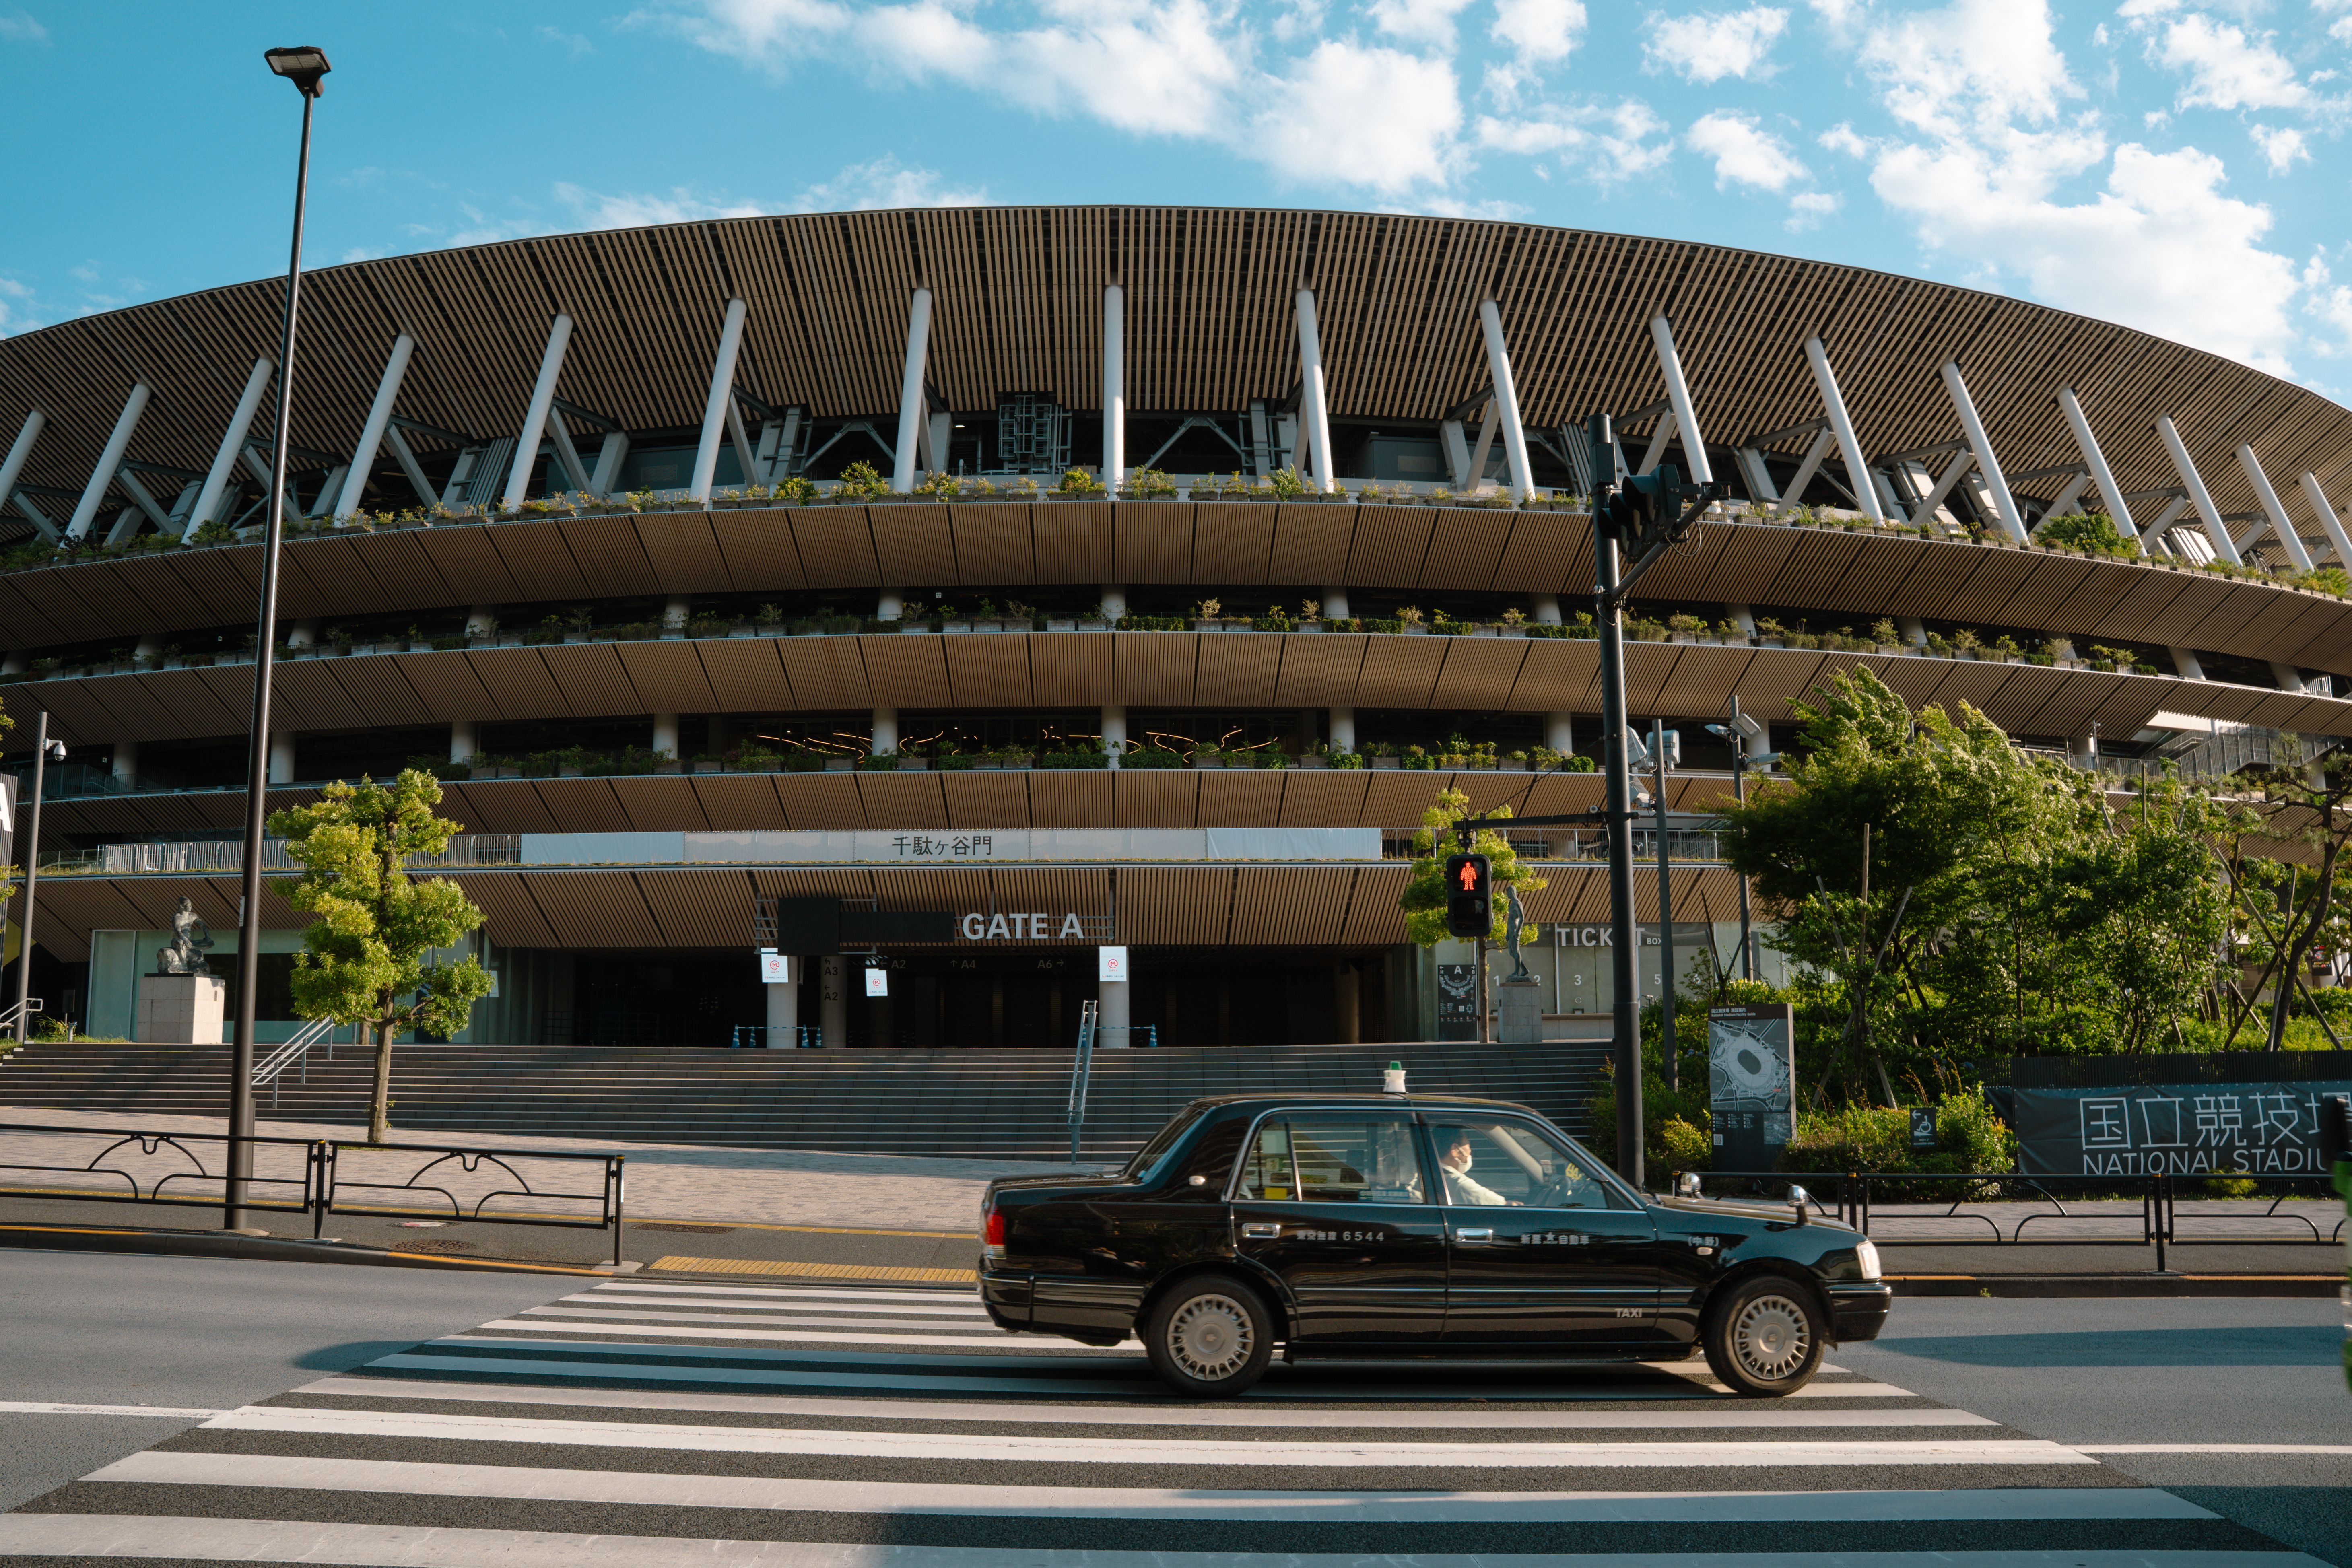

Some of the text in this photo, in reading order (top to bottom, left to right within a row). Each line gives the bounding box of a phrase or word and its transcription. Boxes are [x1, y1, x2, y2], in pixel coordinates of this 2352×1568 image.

[892, 836, 992, 855] 千駄ヶ谷門
[963, 913, 1084, 940] GATE A
[1556, 927, 1645, 946] TICKT
[891, 960, 906, 969] A2
[961, 960, 976, 969] A4
[1037, 959, 1053, 969] A6
[824, 966, 838, 976] A3
[1454, 965, 1462, 974] A
[1493, 975, 1499, 986] 1
[1574, 975, 1581, 985] 3
[1654, 974, 1661, 985] 5
[824, 992, 838, 1001] A2
[1342, 1231, 1385, 1242] 6544
[1614, 1308, 1642, 1318] TAXI
